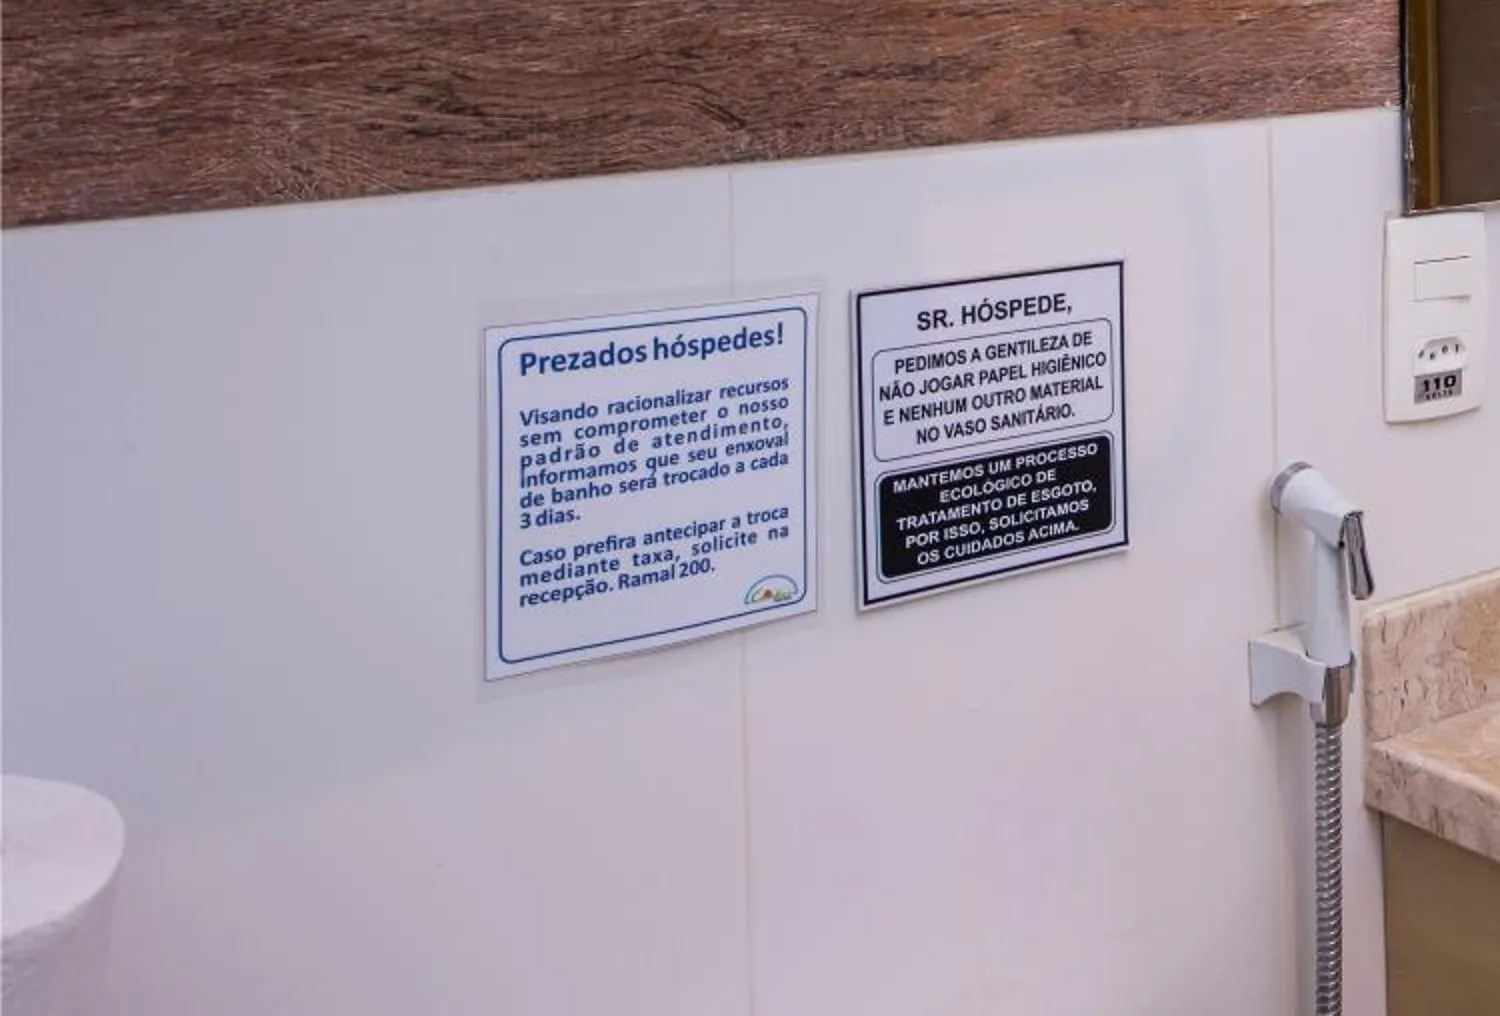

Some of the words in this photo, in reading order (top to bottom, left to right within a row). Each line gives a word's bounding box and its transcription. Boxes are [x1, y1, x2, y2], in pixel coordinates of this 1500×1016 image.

[917, 310, 954, 331] SR.
[962, 293, 1072, 325] HÓSPEDE,
[520, 342, 647, 375] Prezados
[653, 323, 784, 361] hóspedes!
[895, 351, 967, 374] PEDIMOS
[971, 349, 981, 363] A
[985, 335, 1069, 360] GENTILEZA
[1072, 332, 1092, 347] DE
[879, 381, 914, 401] NÃO
[919, 372, 974, 395] JOGAR
[980, 366, 1027, 385] PAPEL
[1031, 351, 1107, 377] HIGIÊNICO
[884, 410, 894, 425] E
[899, 400, 967, 423] NENHUM
[972, 387, 1026, 410] OUTRO
[1030, 375, 1104, 401] MATERIAL
[1423, 375, 1456, 392] 110
[520, 403, 598, 426] Visando
[607, 388, 712, 413] racionalizar
[720, 378, 788, 398] recursos
[520, 431, 561, 447] sem
[575, 410, 707, 439] comprometer
[717, 406, 728, 418] o
[739, 396, 788, 414] nosso
[917, 427, 939, 444] NO
[943, 419, 987, 439] VASO
[991, 401, 1075, 432] SANITÁRIO.
[520, 445, 601, 471] padrão
[614, 438, 639, 454] de
[652, 417, 788, 448] atendimento,
[521, 460, 637, 487] informamos
[646, 452, 679, 473] que
[688, 447, 717, 463] seu
[725, 433, 788, 456] enxoval
[893, 465, 984, 493] MANTEMOS
[988, 458, 1012, 474] UM
[1016, 443, 1098, 469] PROCESSO
[520, 491, 544, 508] de
[551, 483, 612, 504] banho
[619, 471, 657, 493] será
[663, 464, 729, 486] trocado
[735, 461, 745, 473] a
[751, 452, 788, 471] cada
[939, 474, 1033, 503] ECOLÓGICO
[1036, 468, 1057, 483] DE
[520, 514, 531, 528] 3
[536, 509, 580, 524] dias.
[520, 549, 565, 566] Caso
[573, 535, 636, 559] prefira
[643, 520, 725, 546] antecipar
[731, 516, 741, 529] a
[747, 506, 788, 524] troca
[896, 498, 1002, 531] TRATAMENTO
[1007, 492, 1027, 508] DE
[905, 531, 939, 549] POR
[989, 499, 1089, 531] SOLICITAMOS
[520, 559, 620, 586] mediante
[633, 550, 680, 567] taxa,
[691, 531, 757, 556] solicite
[768, 526, 788, 540] na
[917, 549, 939, 565] OS
[945, 531, 1025, 559] CUIDADOS
[1029, 519, 1079, 540] ACIMA.
[520, 583, 614, 606] recepção.
[618, 567, 675, 589] Ramal
[679, 558, 715, 577] 200.
